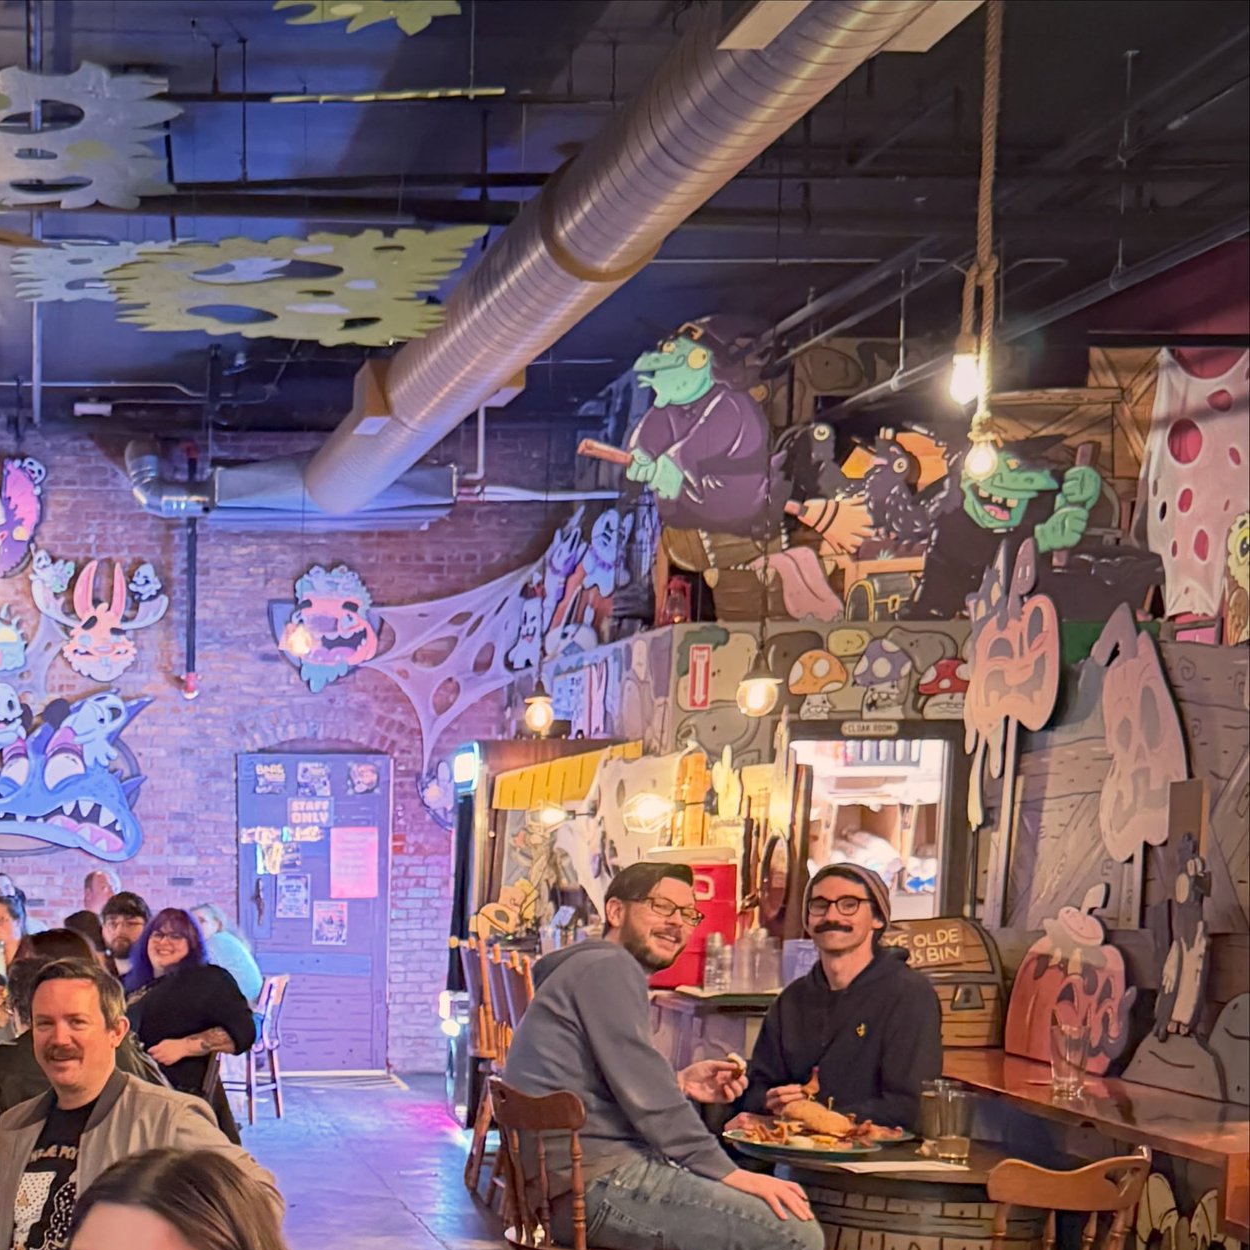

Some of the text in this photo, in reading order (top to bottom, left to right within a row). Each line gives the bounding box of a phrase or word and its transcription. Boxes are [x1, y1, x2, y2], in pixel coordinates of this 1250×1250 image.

[847, 724, 893, 733] CLOAK ROOM
[291, 800, 329, 811] STAFF
[291, 812, 329, 824] ONLY
[913, 928, 959, 948] OLDE
[926, 946, 960, 962] BIN
